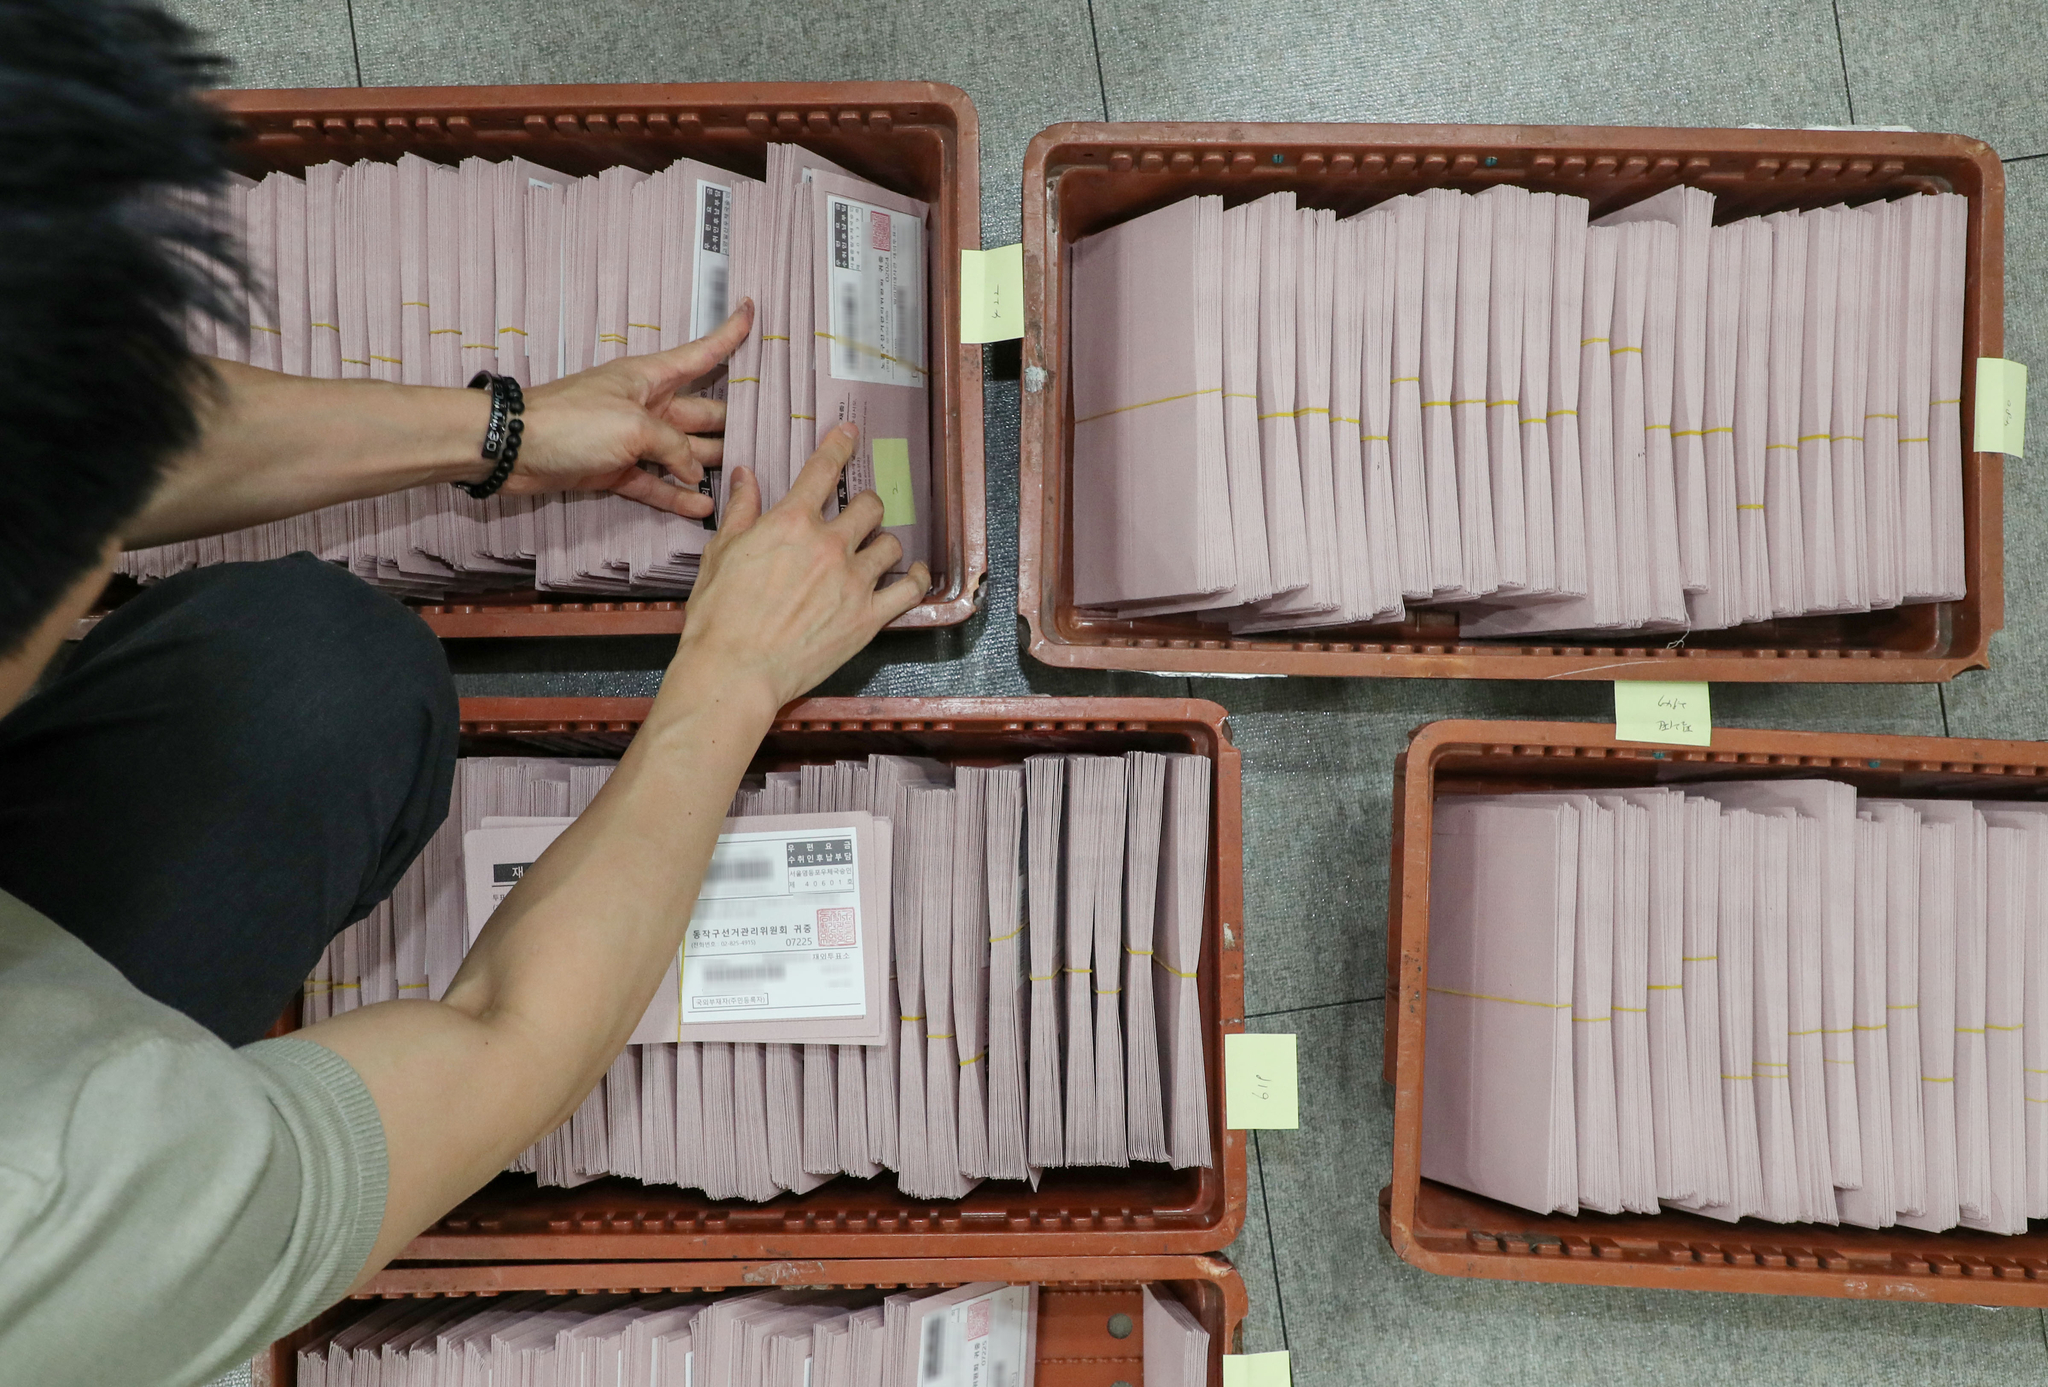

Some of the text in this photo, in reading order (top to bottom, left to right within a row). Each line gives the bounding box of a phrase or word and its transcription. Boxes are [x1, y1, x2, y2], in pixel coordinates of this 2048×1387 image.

[788, 852, 852, 864] 수취인후납부담
[805, 879, 842, 888] 40601
[692, 923, 812, 940] 동작구선거관리위원회 귀중
[785, 937, 813, 947] 07225
[812, 952, 850, 961] 재외투표소
